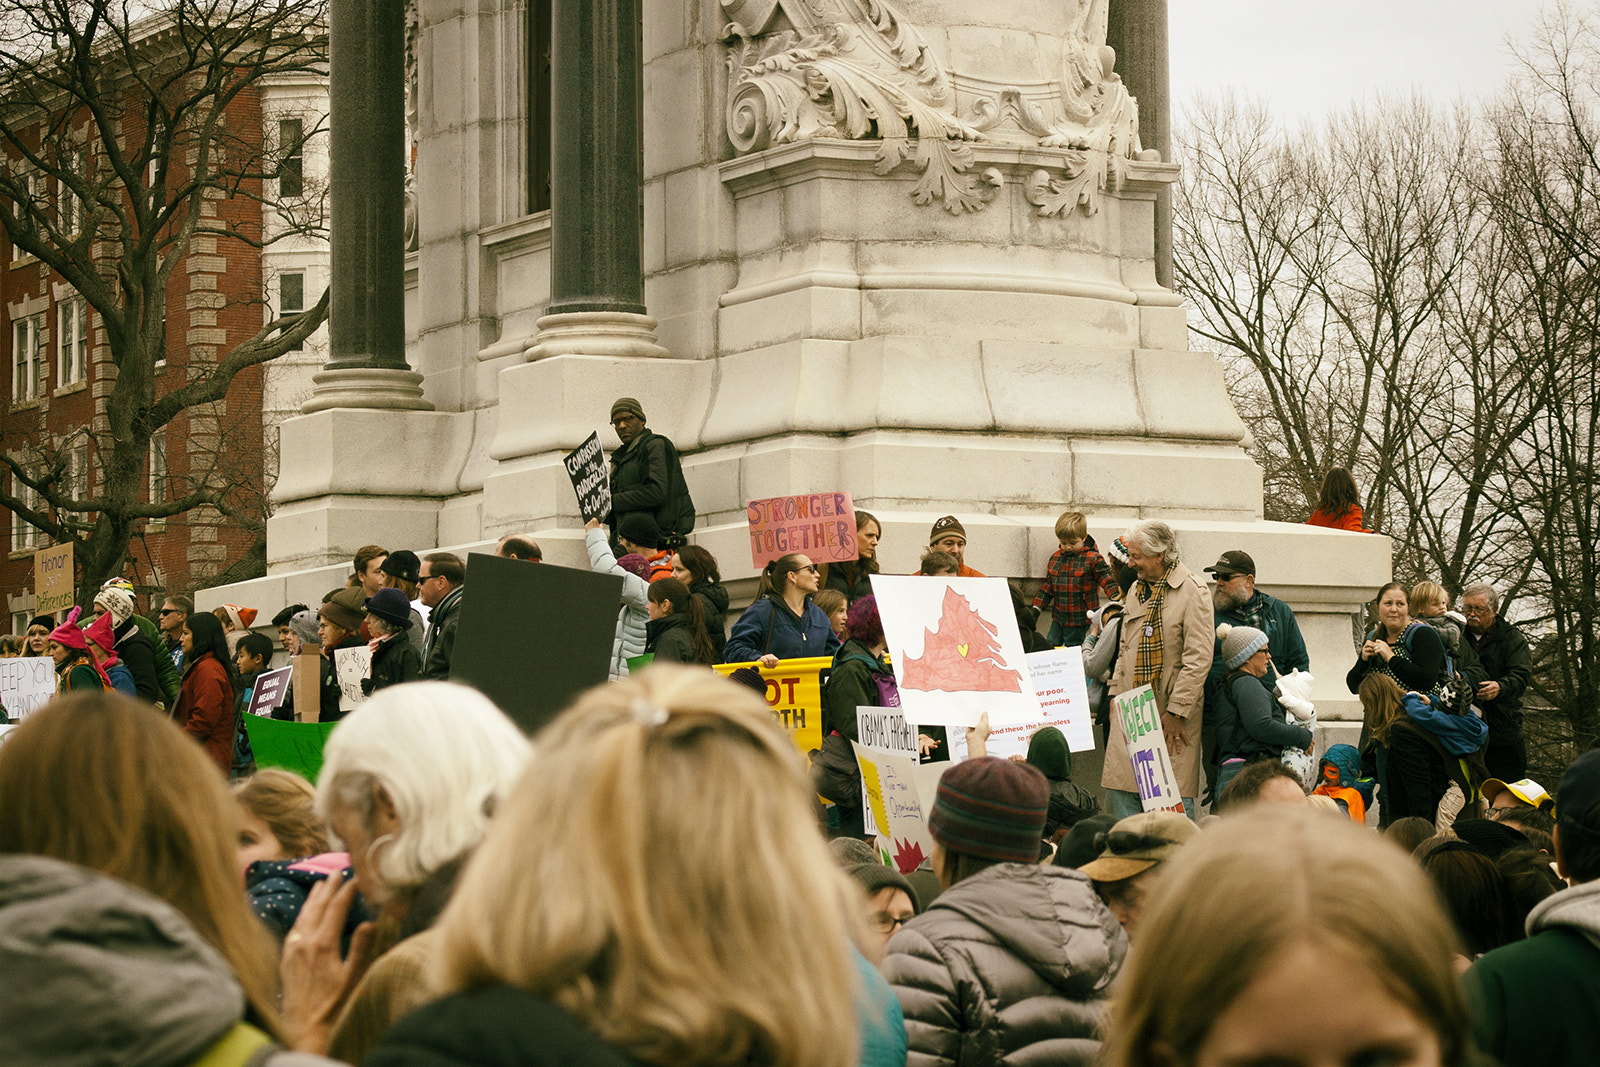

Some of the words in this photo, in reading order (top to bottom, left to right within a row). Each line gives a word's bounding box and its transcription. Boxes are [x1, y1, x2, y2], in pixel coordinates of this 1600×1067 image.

[567, 438, 601, 476] COMPASSION
[748, 493, 846, 525] STRONGER
[750, 520, 850, 554] TOGETHER
[41, 553, 69, 574] Honor
[0, 661, 27, 692] EEP
[28, 659, 54, 688] YOU
[262, 676, 280, 690] EQUAL
[765, 677, 800, 706] OT
[258, 690, 278, 704] MEANS
[1040, 697, 1070, 708] yearning
[861, 714, 890, 749] OBAMA'S
[1117, 689, 1158, 744] EJECT
